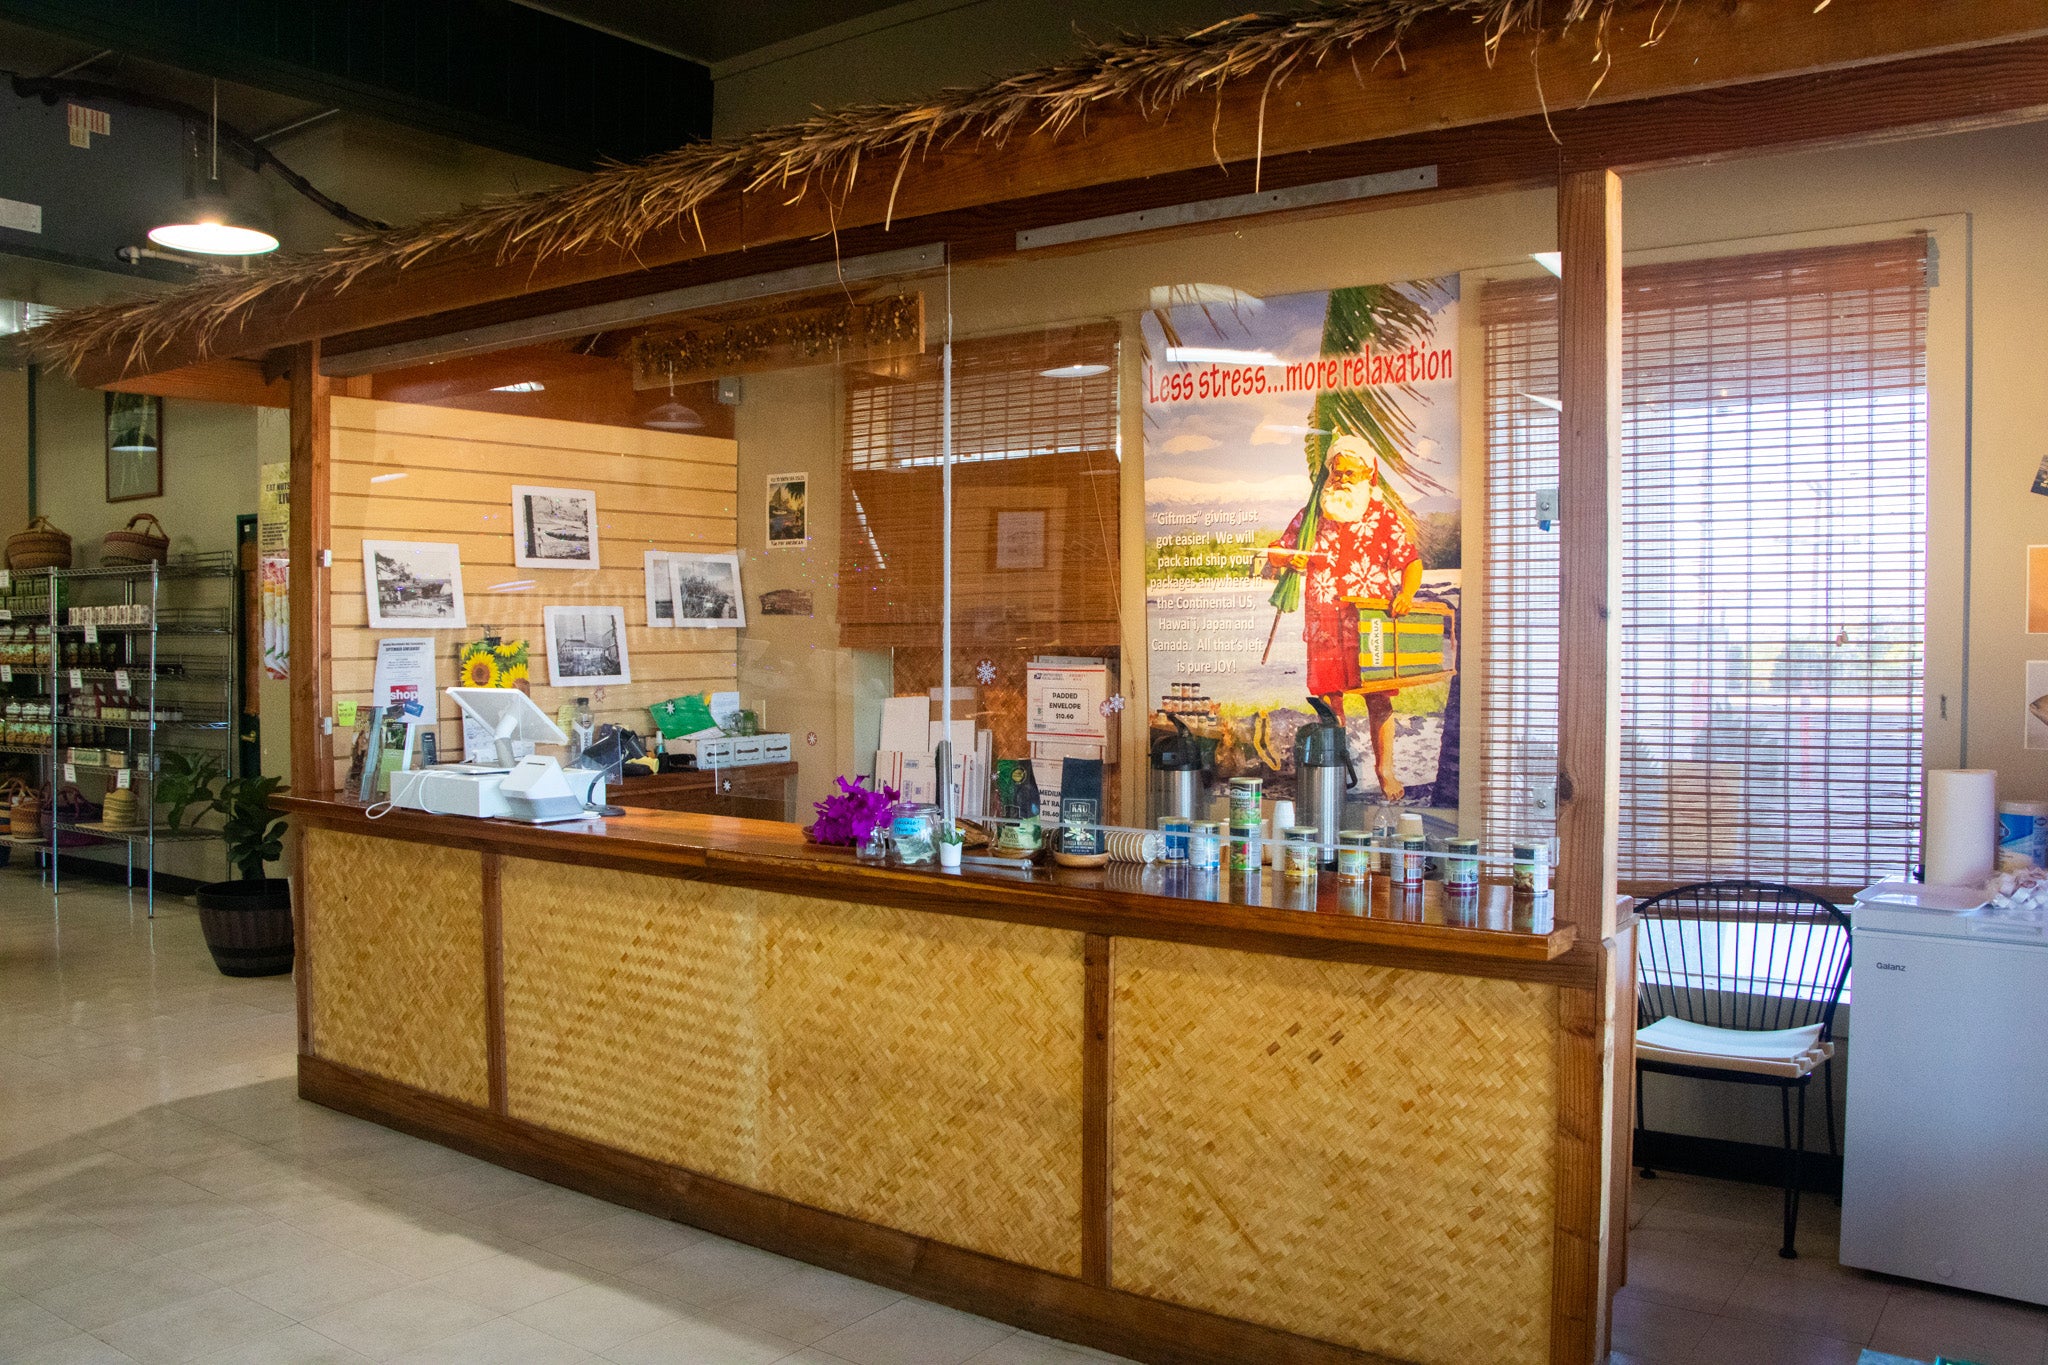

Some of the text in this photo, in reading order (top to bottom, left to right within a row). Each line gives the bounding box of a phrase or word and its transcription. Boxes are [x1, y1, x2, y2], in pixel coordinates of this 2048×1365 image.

[1149, 366, 1195, 404] Less
[1343, 341, 1453, 391] relaxation
[266, 484, 275, 492] EAT
[1205, 510, 1236, 526] giving
[1236, 509, 1258, 525] just
[1156, 529, 1255, 549] got easier! We will
[1157, 553, 1254, 570] pack and ship your
[1150, 573, 1264, 592] packages anywhere in
[1157, 594, 1256, 611] the Continental US,
[1201, 618, 1233, 634] Japan
[1234, 616, 1256, 631] and
[1151, 638, 1193, 652] Canada.
[1197, 638, 1212, 652] All
[1245, 637, 1264, 652] left
[1177, 659, 1237, 676] is pure JOY!
[391, 690, 418, 702] shop
[1876, 962, 1906, 971] Galanz
